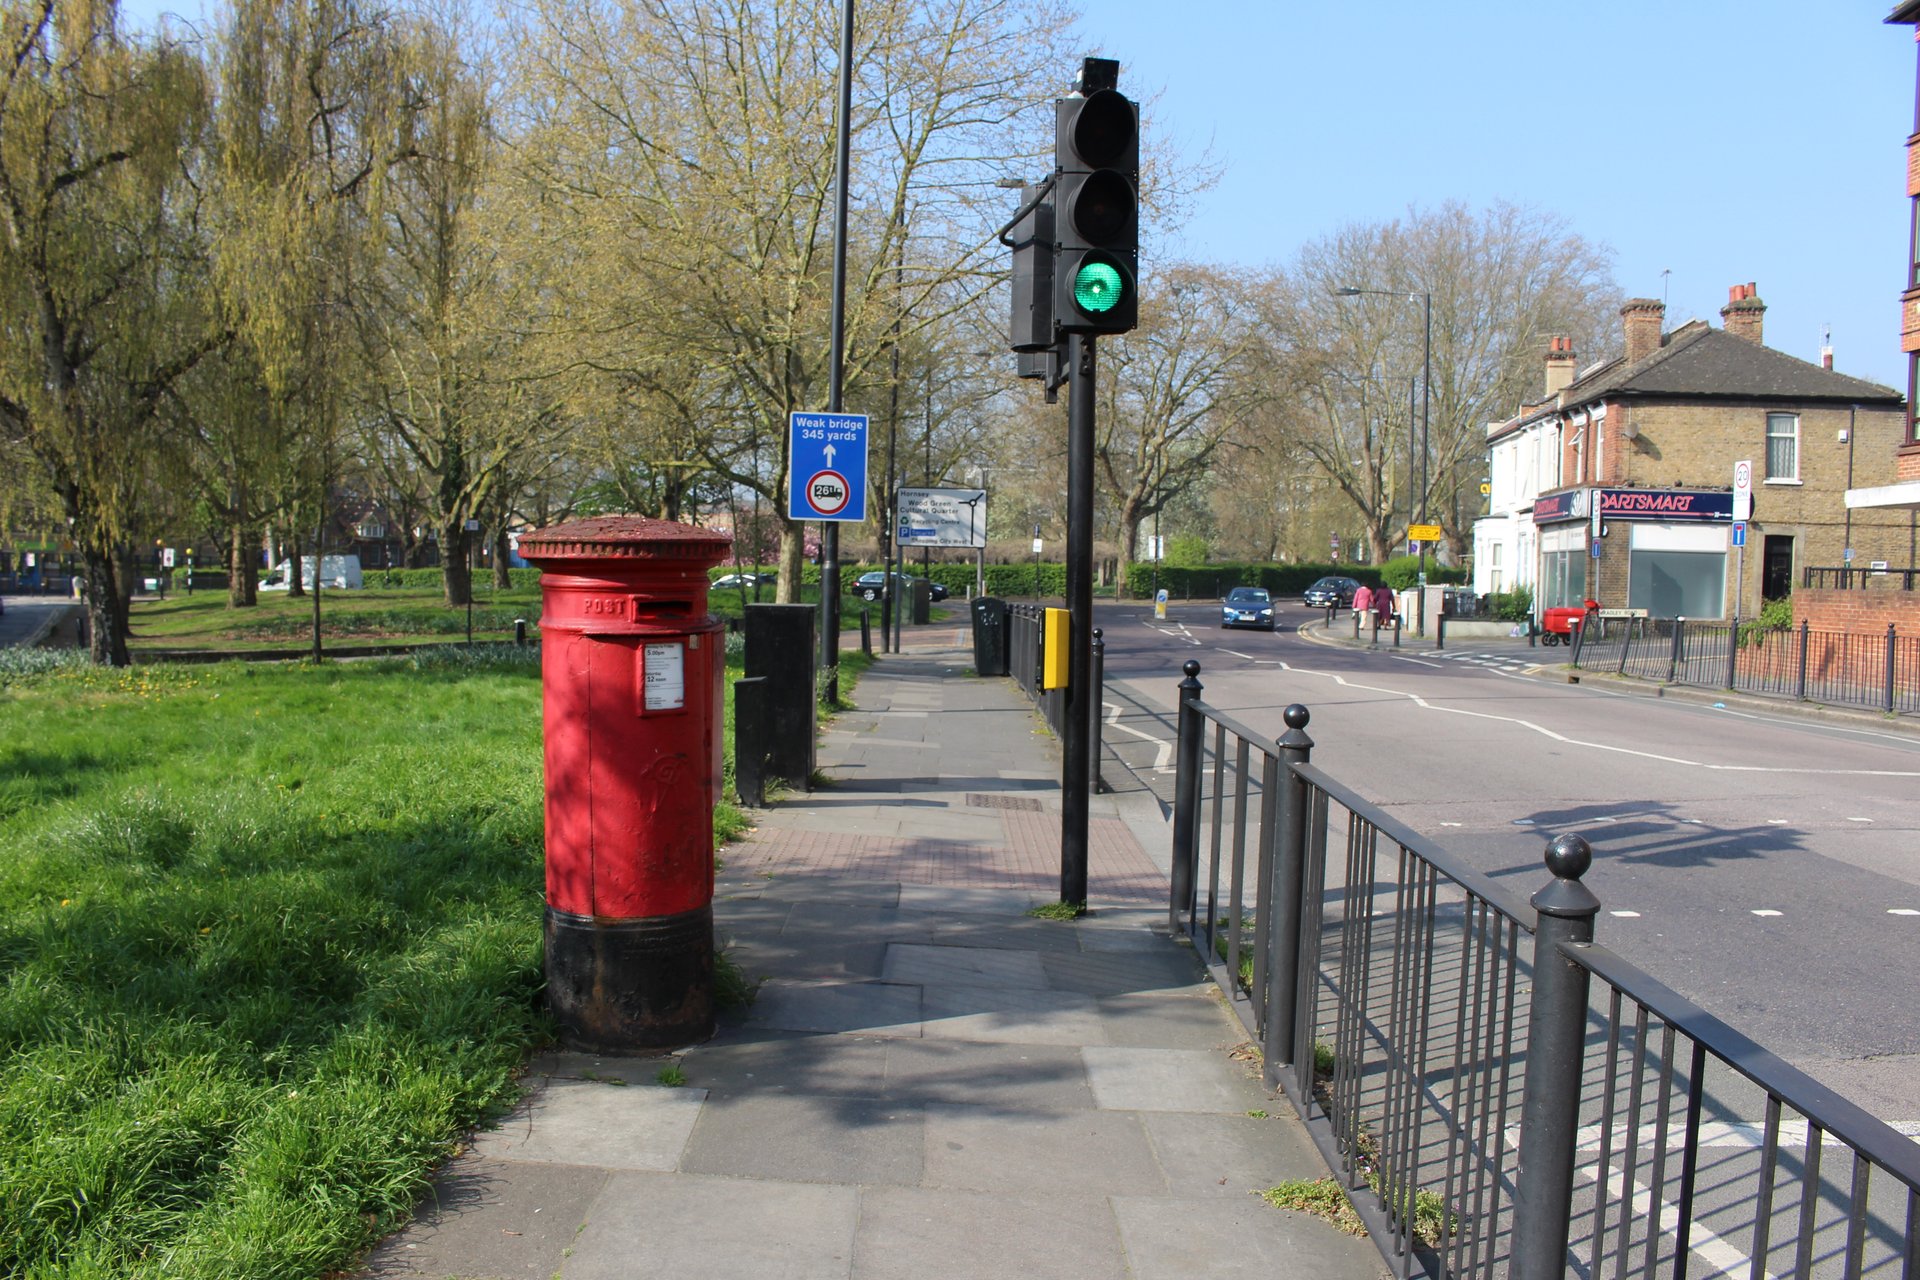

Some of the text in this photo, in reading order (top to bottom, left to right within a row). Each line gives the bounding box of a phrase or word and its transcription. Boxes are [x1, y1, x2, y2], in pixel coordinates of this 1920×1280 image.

[796, 417, 863, 431] Weak bridge
[802, 429, 857, 441] 345 yards
[1738, 470, 1748, 481] 20
[1602, 493, 1694, 510] DARTSMART
[901, 527, 908, 537] P
[584, 599, 626, 614] POST
